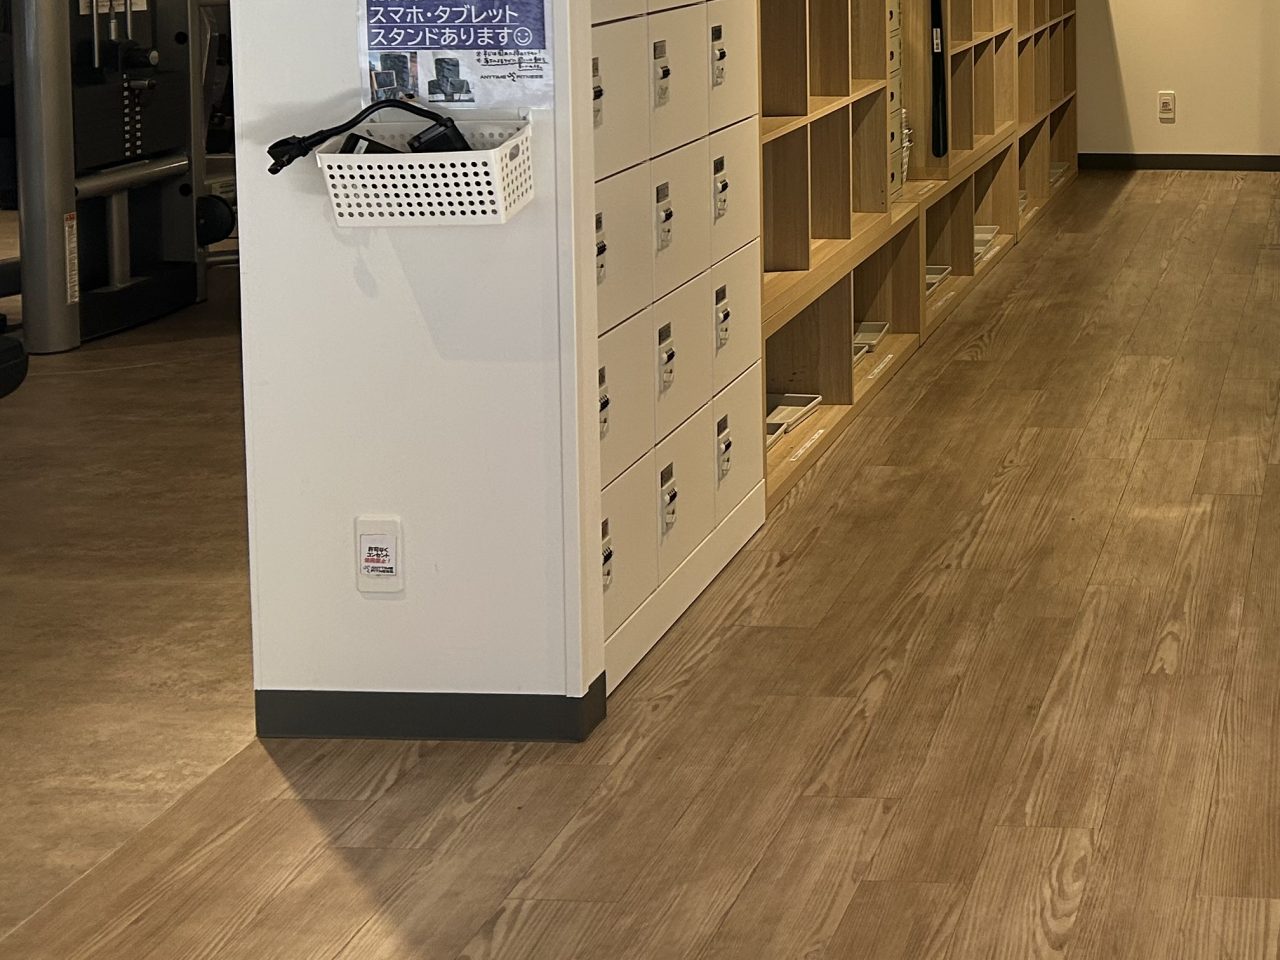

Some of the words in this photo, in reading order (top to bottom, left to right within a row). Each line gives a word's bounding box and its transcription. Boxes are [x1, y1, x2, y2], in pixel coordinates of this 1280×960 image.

[369, 5, 519, 24] スマホ・タブレット
[370, 27, 513, 46] スタンドあります
